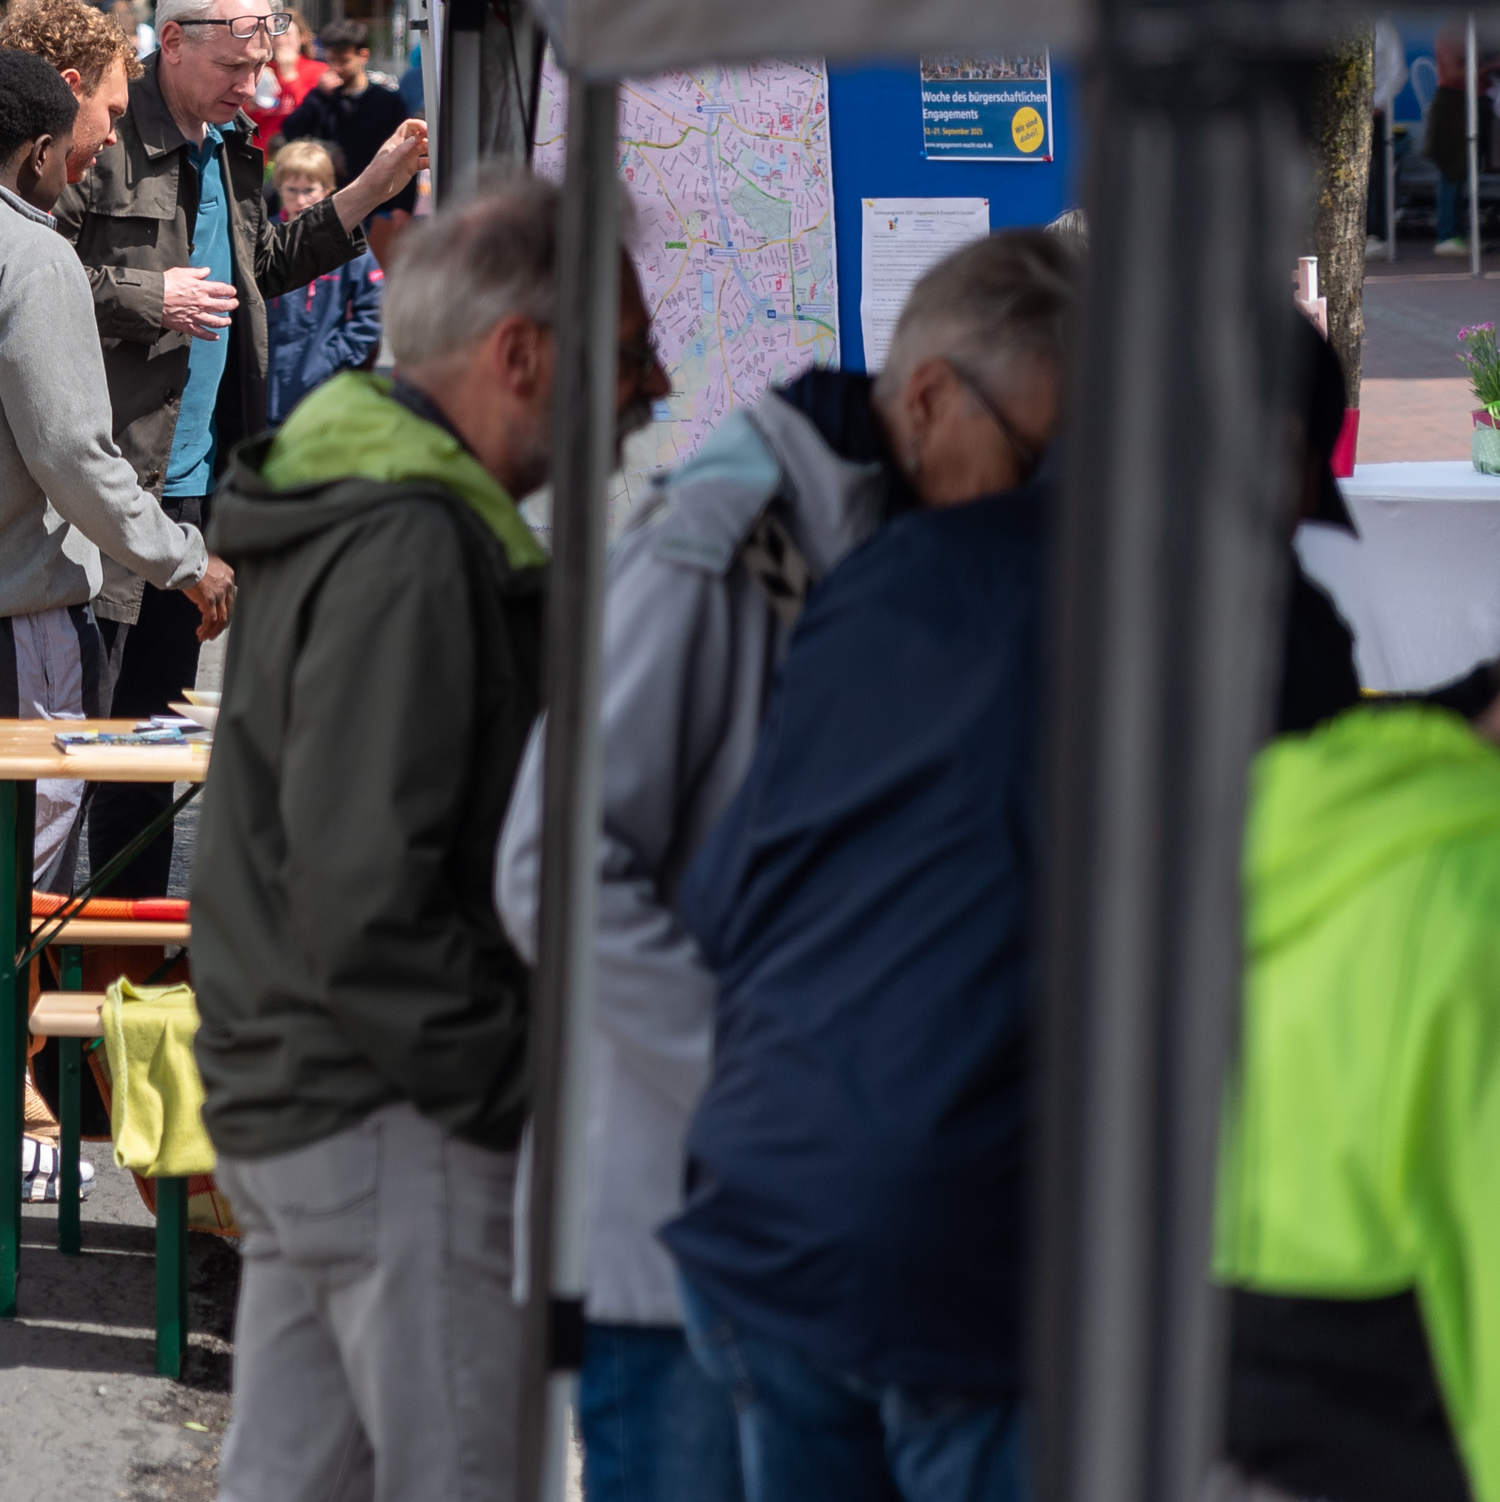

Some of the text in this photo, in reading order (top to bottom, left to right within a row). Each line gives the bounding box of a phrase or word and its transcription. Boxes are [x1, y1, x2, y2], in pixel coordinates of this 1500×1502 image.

[922, 91, 1048, 105] Woche des bürgerschaftlichen
[923, 108, 979, 122] Engagements
[942, 127, 970, 137] September
[970, 127, 983, 135] 2025
[1014, 116, 1038, 135] Wir sind
[1019, 128, 1039, 143] dabei!
